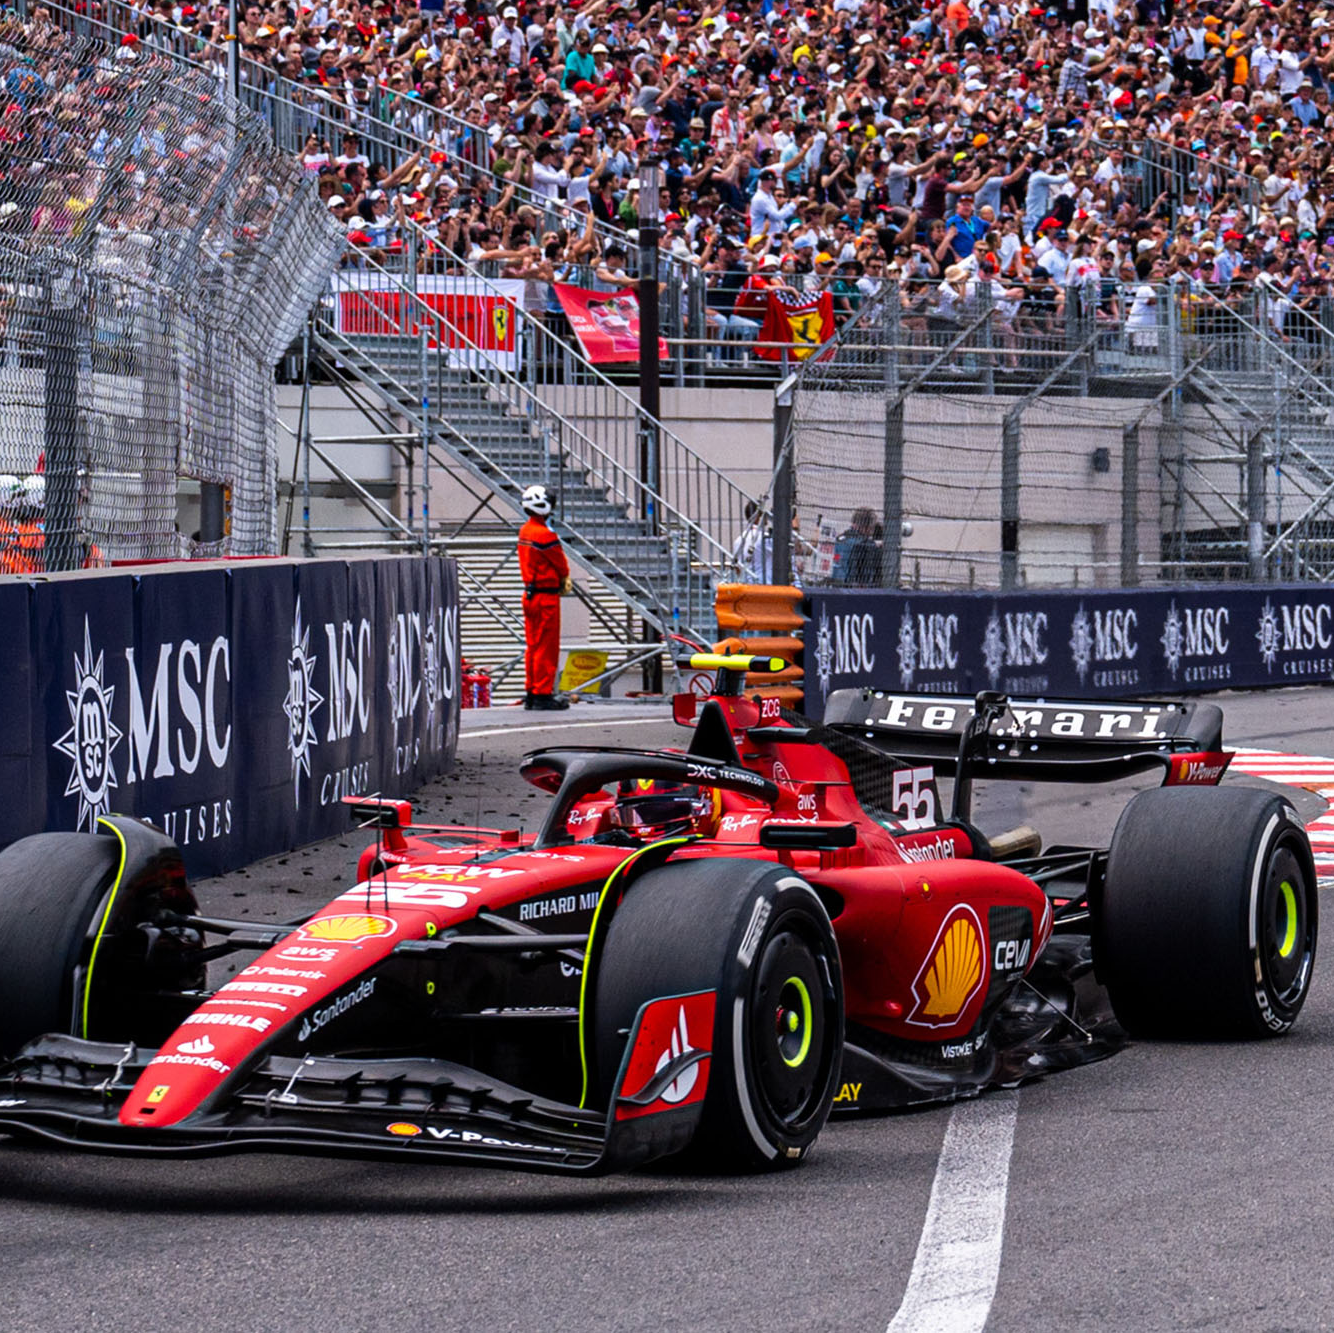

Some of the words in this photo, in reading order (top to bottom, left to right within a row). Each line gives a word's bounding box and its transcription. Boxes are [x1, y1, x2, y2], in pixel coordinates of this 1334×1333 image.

[834, 614, 875, 674] MSC
[918, 614, 958, 670] MSC
[1005, 612, 1048, 667] MSC
[1094, 609, 1138, 661] MSC
[1185, 608, 1229, 657] MSC
[1281, 604, 1332, 651] MSC
[1283, 659, 1333, 675] CRUISES
[125, 636, 232, 785] MSC
[687, 764, 716, 780] DXC
[719, 770, 765, 787] TECHNOLOGY
[797, 794, 816, 810] aws
[892, 767, 936, 831] 55
[143, 799, 233, 846] UISES
[396, 863, 525, 878] VGW
[334, 881, 481, 909] 55
[520, 895, 576, 921] RICHARD
[579, 891, 599, 911] MIL
[258, 966, 327, 980] Palantir
[179, 1012, 272, 1032] MAHLE
[312, 977, 378, 1032] Santander
[147, 1052, 231, 1074] antander
[427, 1126, 567, 1153] V-Power
